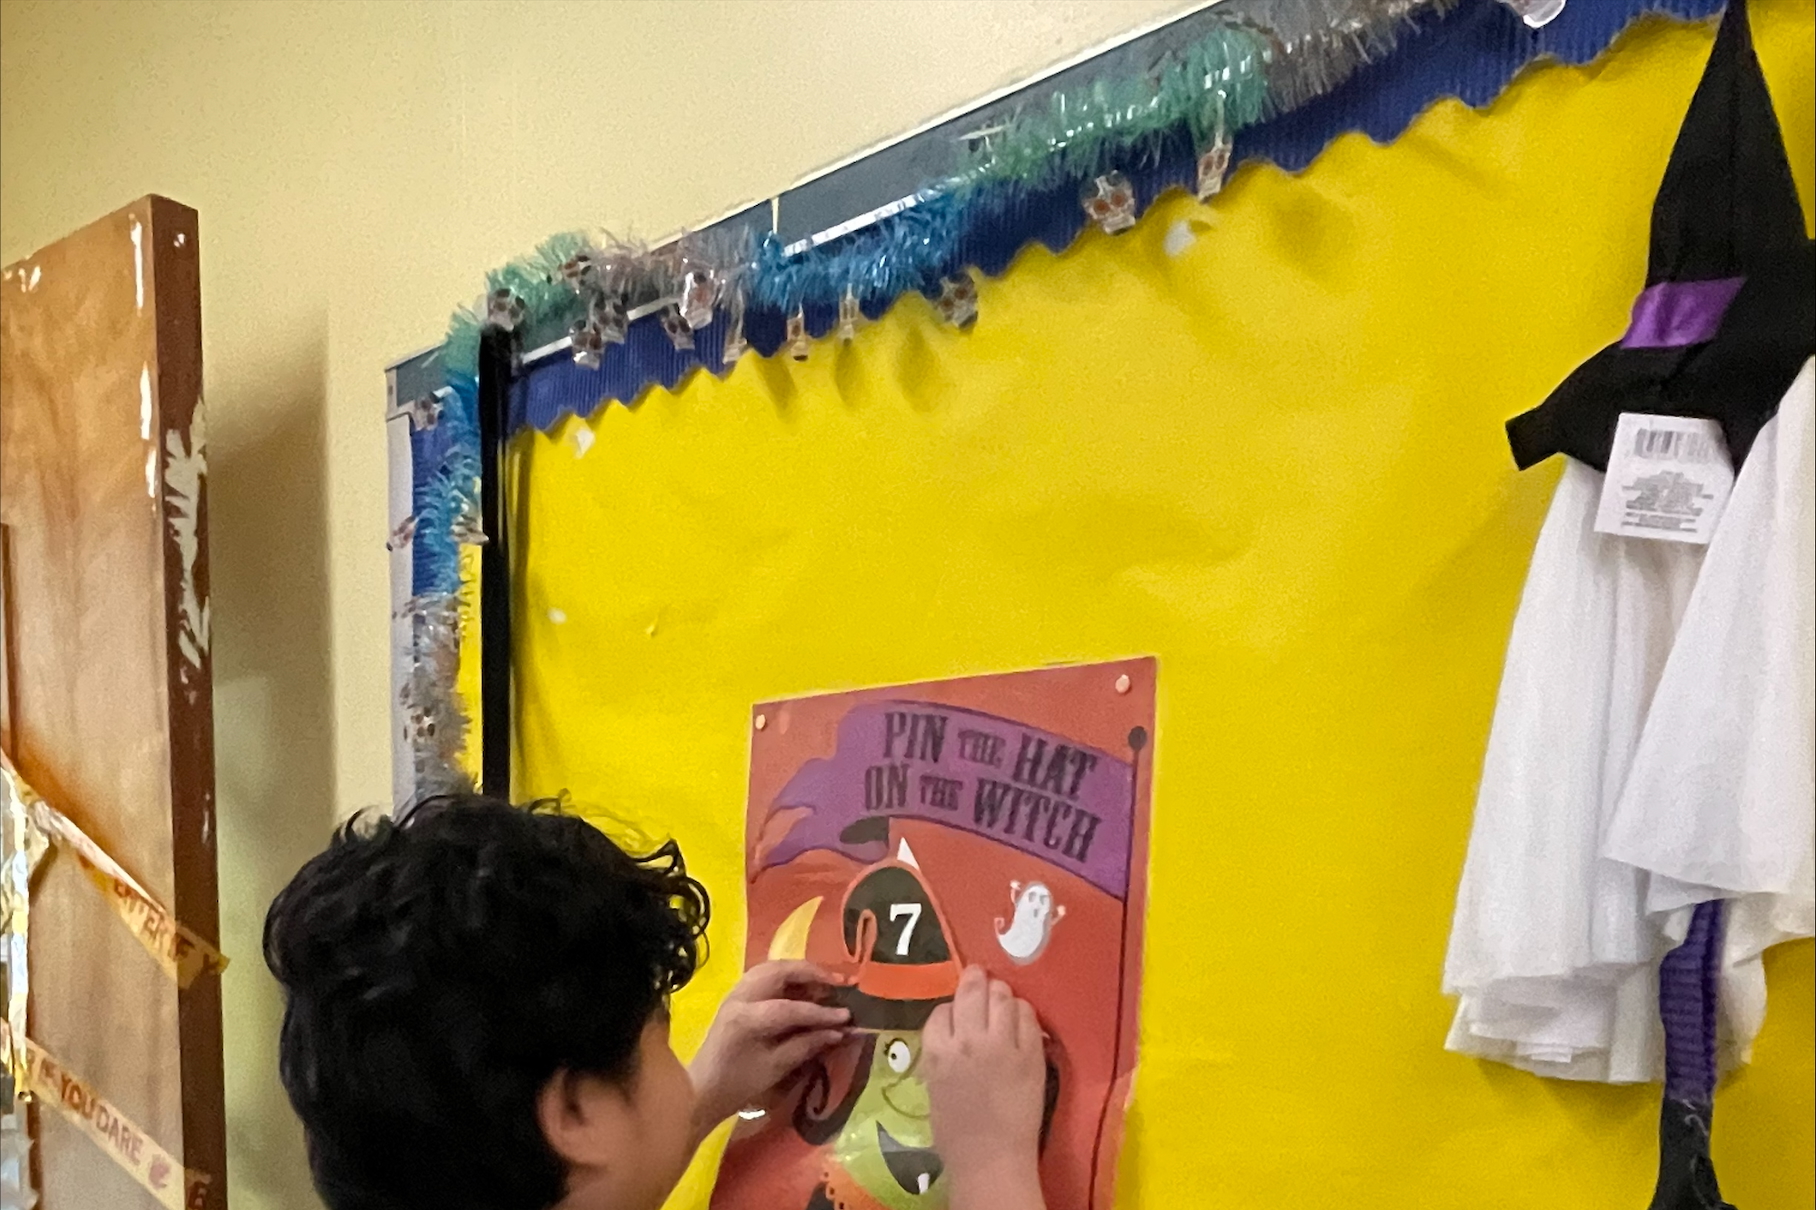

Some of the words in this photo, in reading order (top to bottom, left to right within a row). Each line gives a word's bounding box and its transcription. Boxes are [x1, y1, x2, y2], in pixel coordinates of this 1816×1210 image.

[884, 712, 949, 763] PIN
[958, 729, 1006, 769] THE
[1013, 732, 1098, 800] HAT
[864, 763, 911, 812] ON
[919, 774, 964, 812] THE
[973, 778, 1102, 864] WITCH
[889, 903, 922, 956] 7
[60, 1071, 99, 1120] YOU
[96, 1105, 144, 1167] DARE
